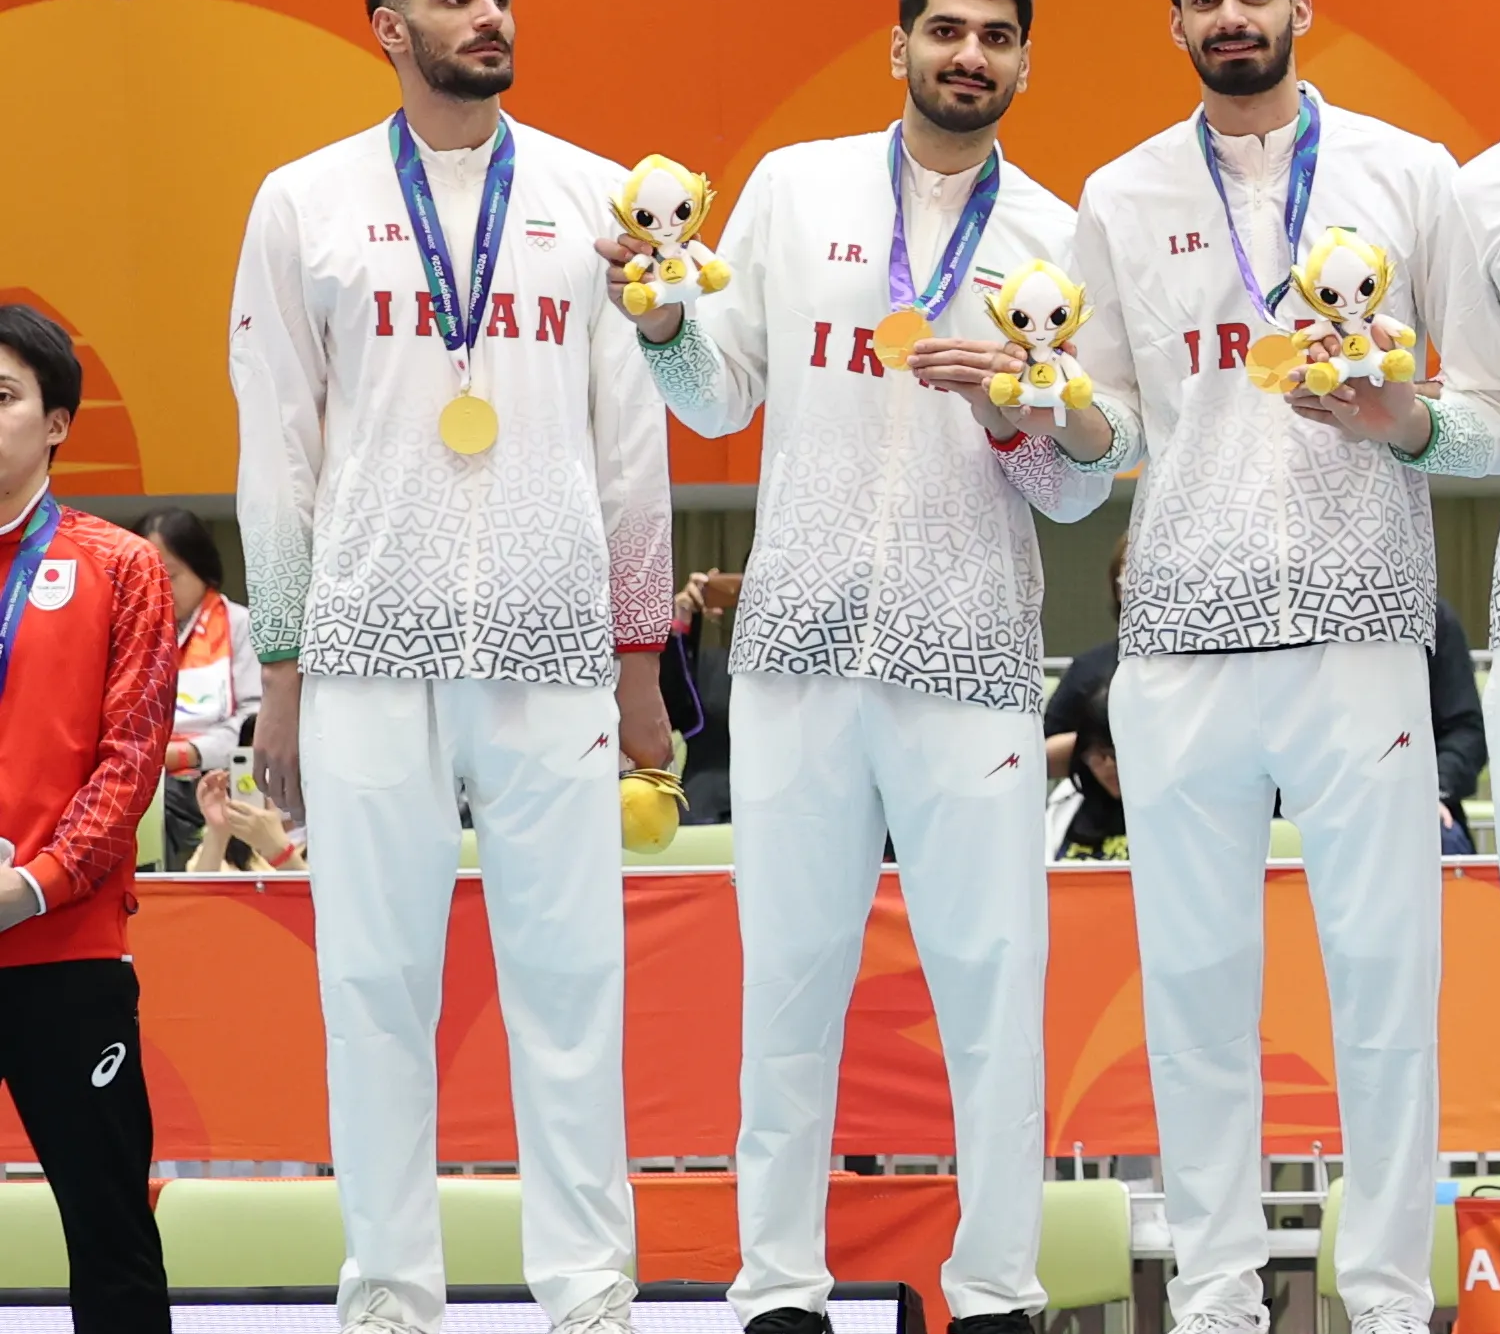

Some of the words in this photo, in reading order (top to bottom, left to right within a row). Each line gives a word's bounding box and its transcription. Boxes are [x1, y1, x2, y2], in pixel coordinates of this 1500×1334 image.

[367, 223, 411, 242] I.R.
[1169, 232, 1209, 255] I.R.
[475, 253, 488, 275] 2026
[828, 243, 868, 263] I.R.
[431, 255, 444, 277] 2026
[374, 290, 571, 346] IRAN
